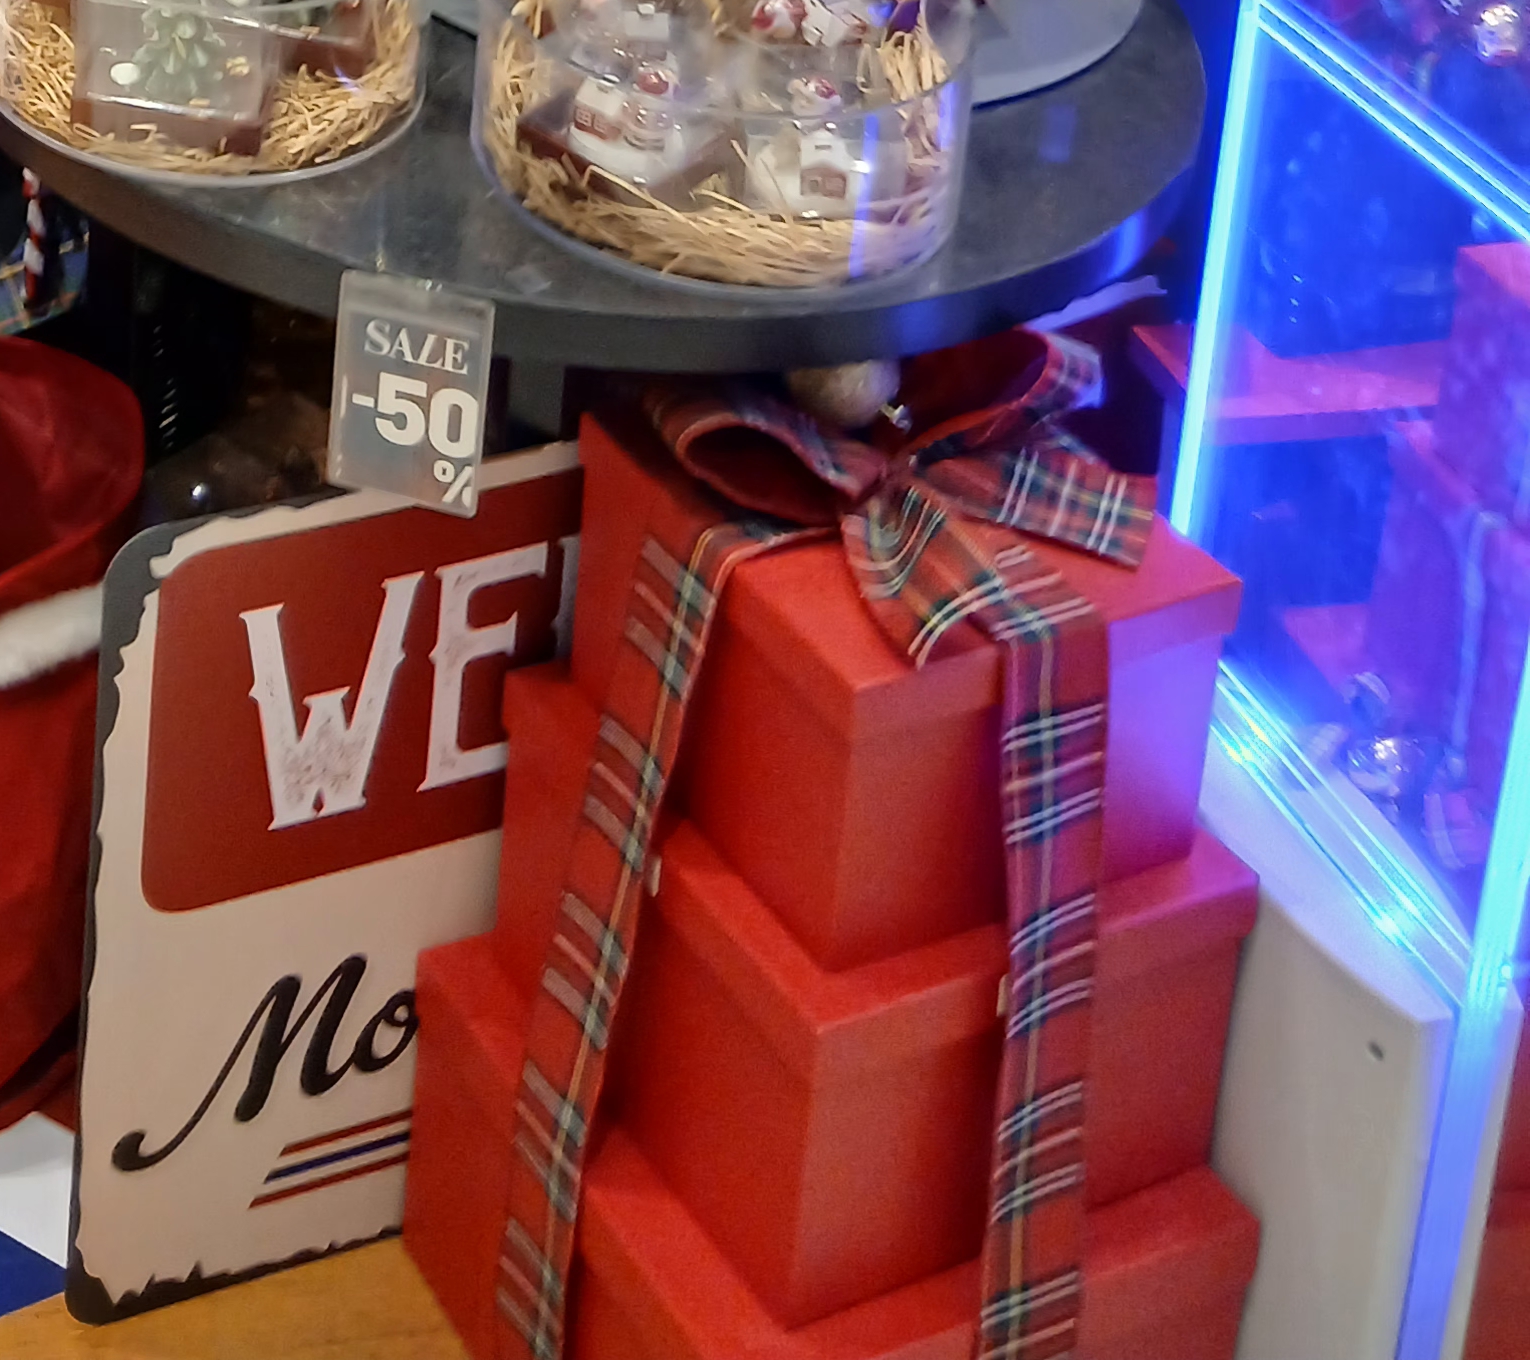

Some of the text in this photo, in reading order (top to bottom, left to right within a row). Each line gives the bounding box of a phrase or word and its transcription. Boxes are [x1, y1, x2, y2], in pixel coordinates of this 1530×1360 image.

[363, 318, 469, 375] SALE
[351, 371, 479, 459] -50
[239, 536, 578, 830] WE
